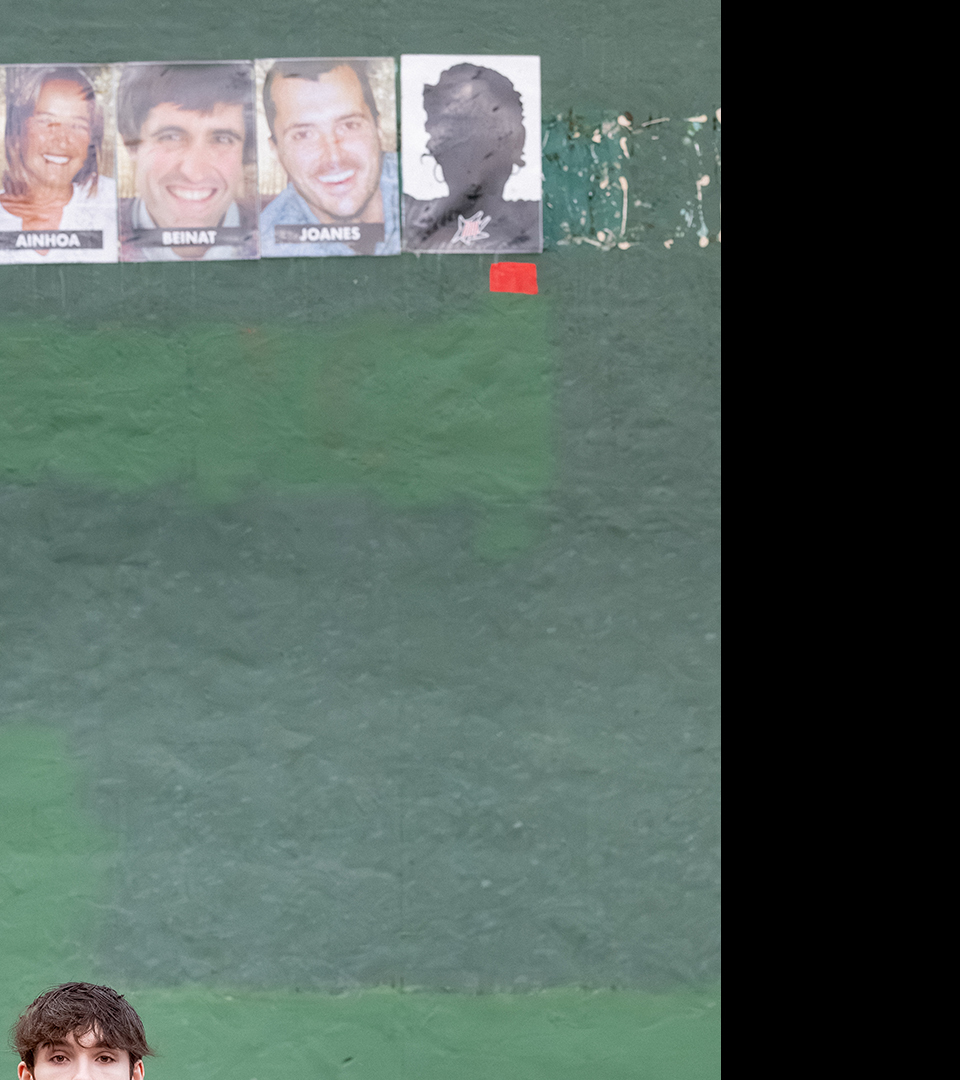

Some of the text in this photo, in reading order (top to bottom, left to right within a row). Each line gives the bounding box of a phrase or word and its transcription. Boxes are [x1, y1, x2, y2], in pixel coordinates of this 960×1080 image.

[15, 233, 81, 247] AINHOA
[162, 230, 217, 245] BEINAT
[299, 226, 361, 242] JOANES
